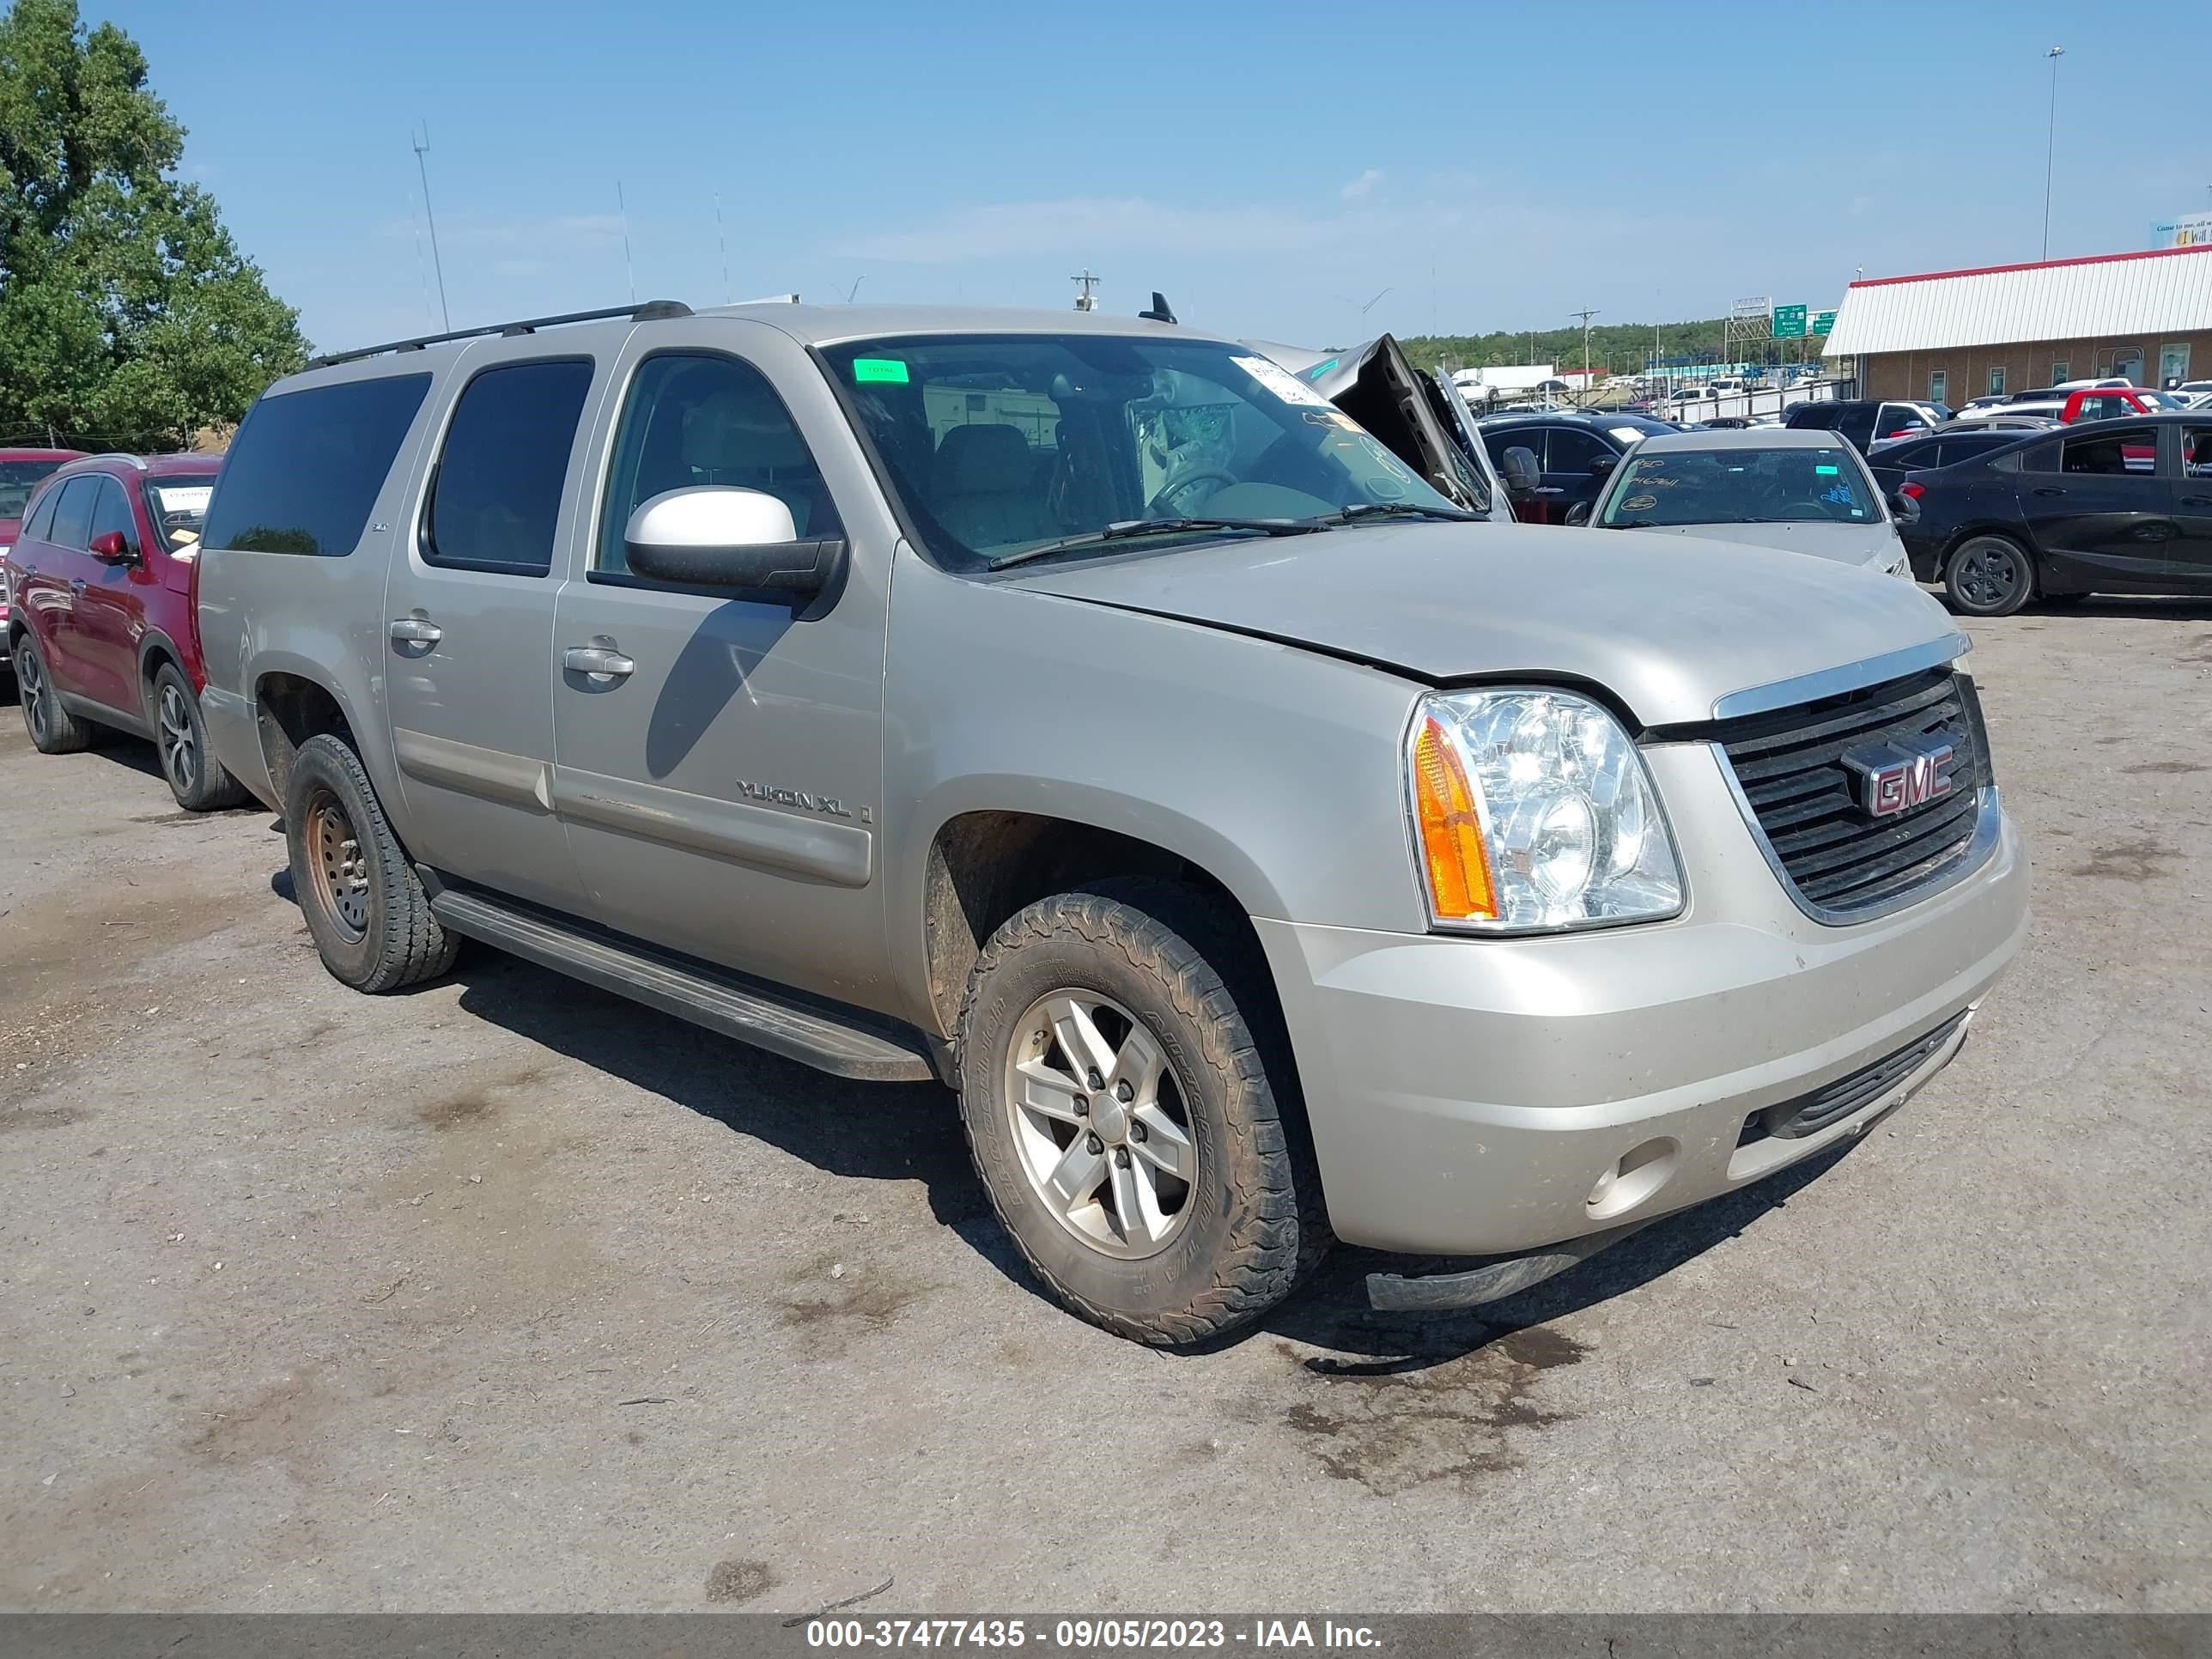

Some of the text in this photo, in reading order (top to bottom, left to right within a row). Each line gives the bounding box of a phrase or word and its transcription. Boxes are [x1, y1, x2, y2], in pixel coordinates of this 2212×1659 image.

[736, 779, 814, 811] YUKON
[817, 796, 852, 818] XL
[1870, 744, 1953, 817] GMC
